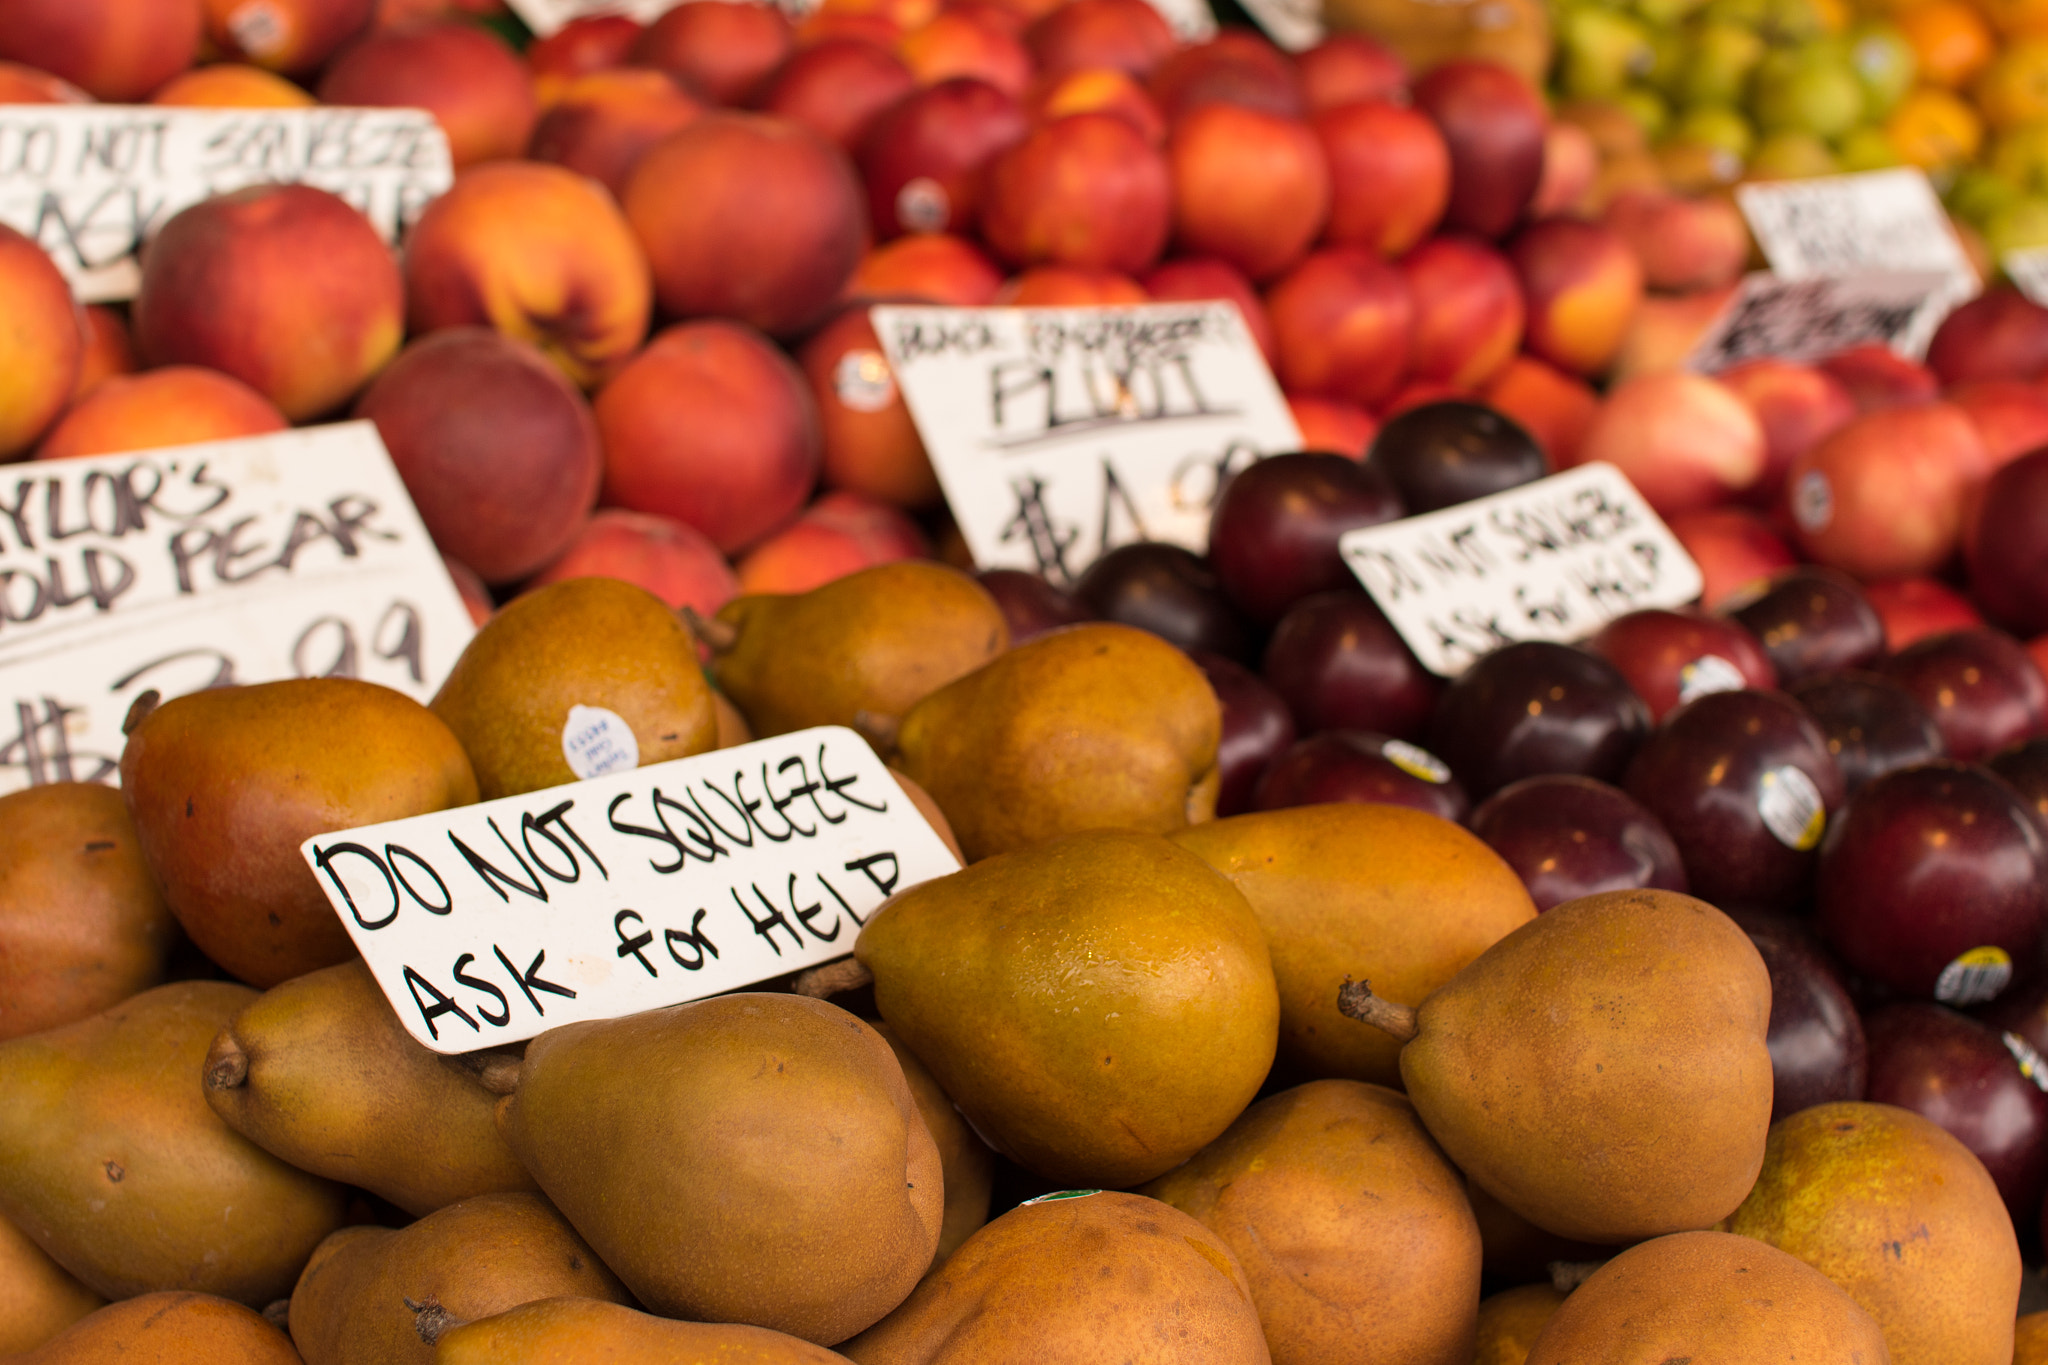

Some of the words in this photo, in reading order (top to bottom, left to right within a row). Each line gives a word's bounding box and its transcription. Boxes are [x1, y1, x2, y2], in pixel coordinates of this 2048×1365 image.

[0, 461, 230, 556] YLOR'S
[0, 549, 135, 626] OLD
[169, 494, 402, 593] PEAR
[314, 841, 453, 931] DO
[448, 800, 609, 903] NOT
[608, 743, 888, 875] SQUEEZE
[402, 942, 577, 1041] ASK
[614, 907, 719, 979] for
[731, 852, 900, 957] HELP
